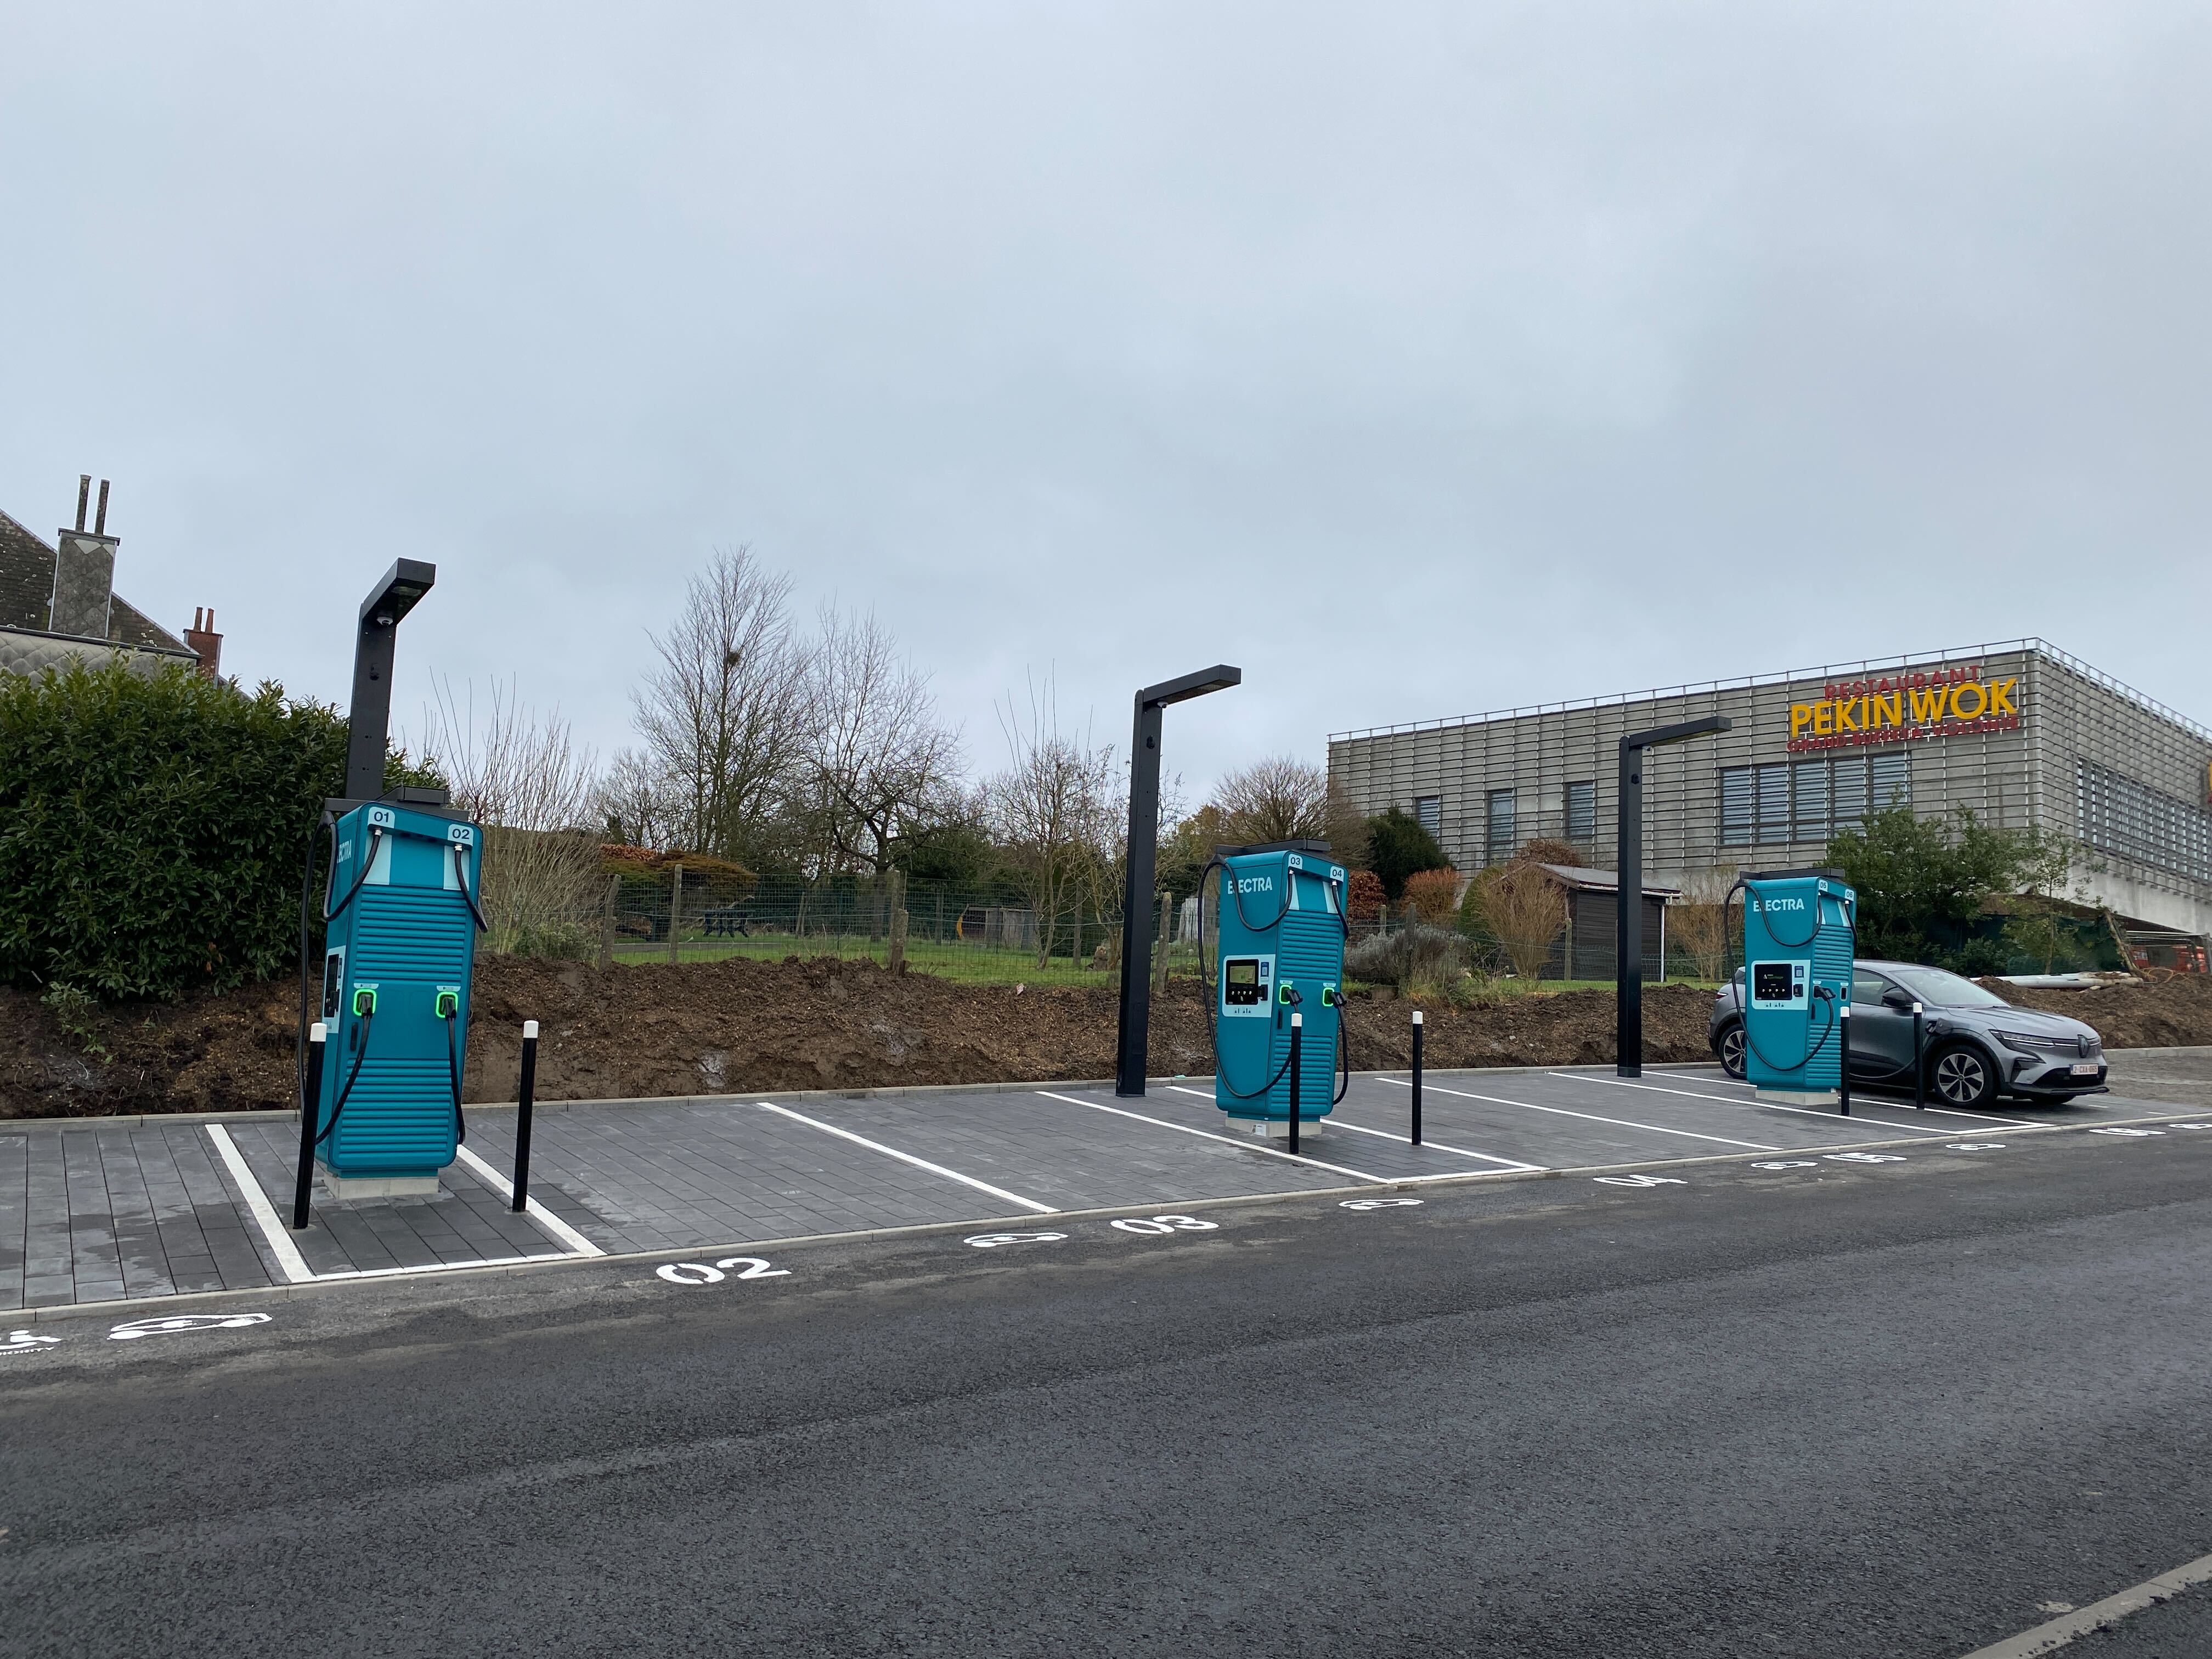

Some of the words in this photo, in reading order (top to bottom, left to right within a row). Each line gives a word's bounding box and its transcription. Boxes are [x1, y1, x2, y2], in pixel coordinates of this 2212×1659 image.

[1824, 665, 1980, 700] RESTAURANT
[1792, 692, 1902, 738] PEKIN
[1910, 678, 2019, 723] WOK
[1787, 733, 1847, 752] GRAND
[374, 811, 389, 823] 01
[452, 828, 470, 839] 02
[1290, 857, 1301, 865] 03
[1332, 869, 1342, 877] 04
[1228, 876, 1273, 894] EECTRA
[1753, 898, 1805, 912] EECTRA
[1822, 1152, 1908, 1163] 05
[1593, 1174, 1689, 1187] 04
[1110, 1215, 1219, 1234] 03
[656, 1257, 792, 1284] 02
